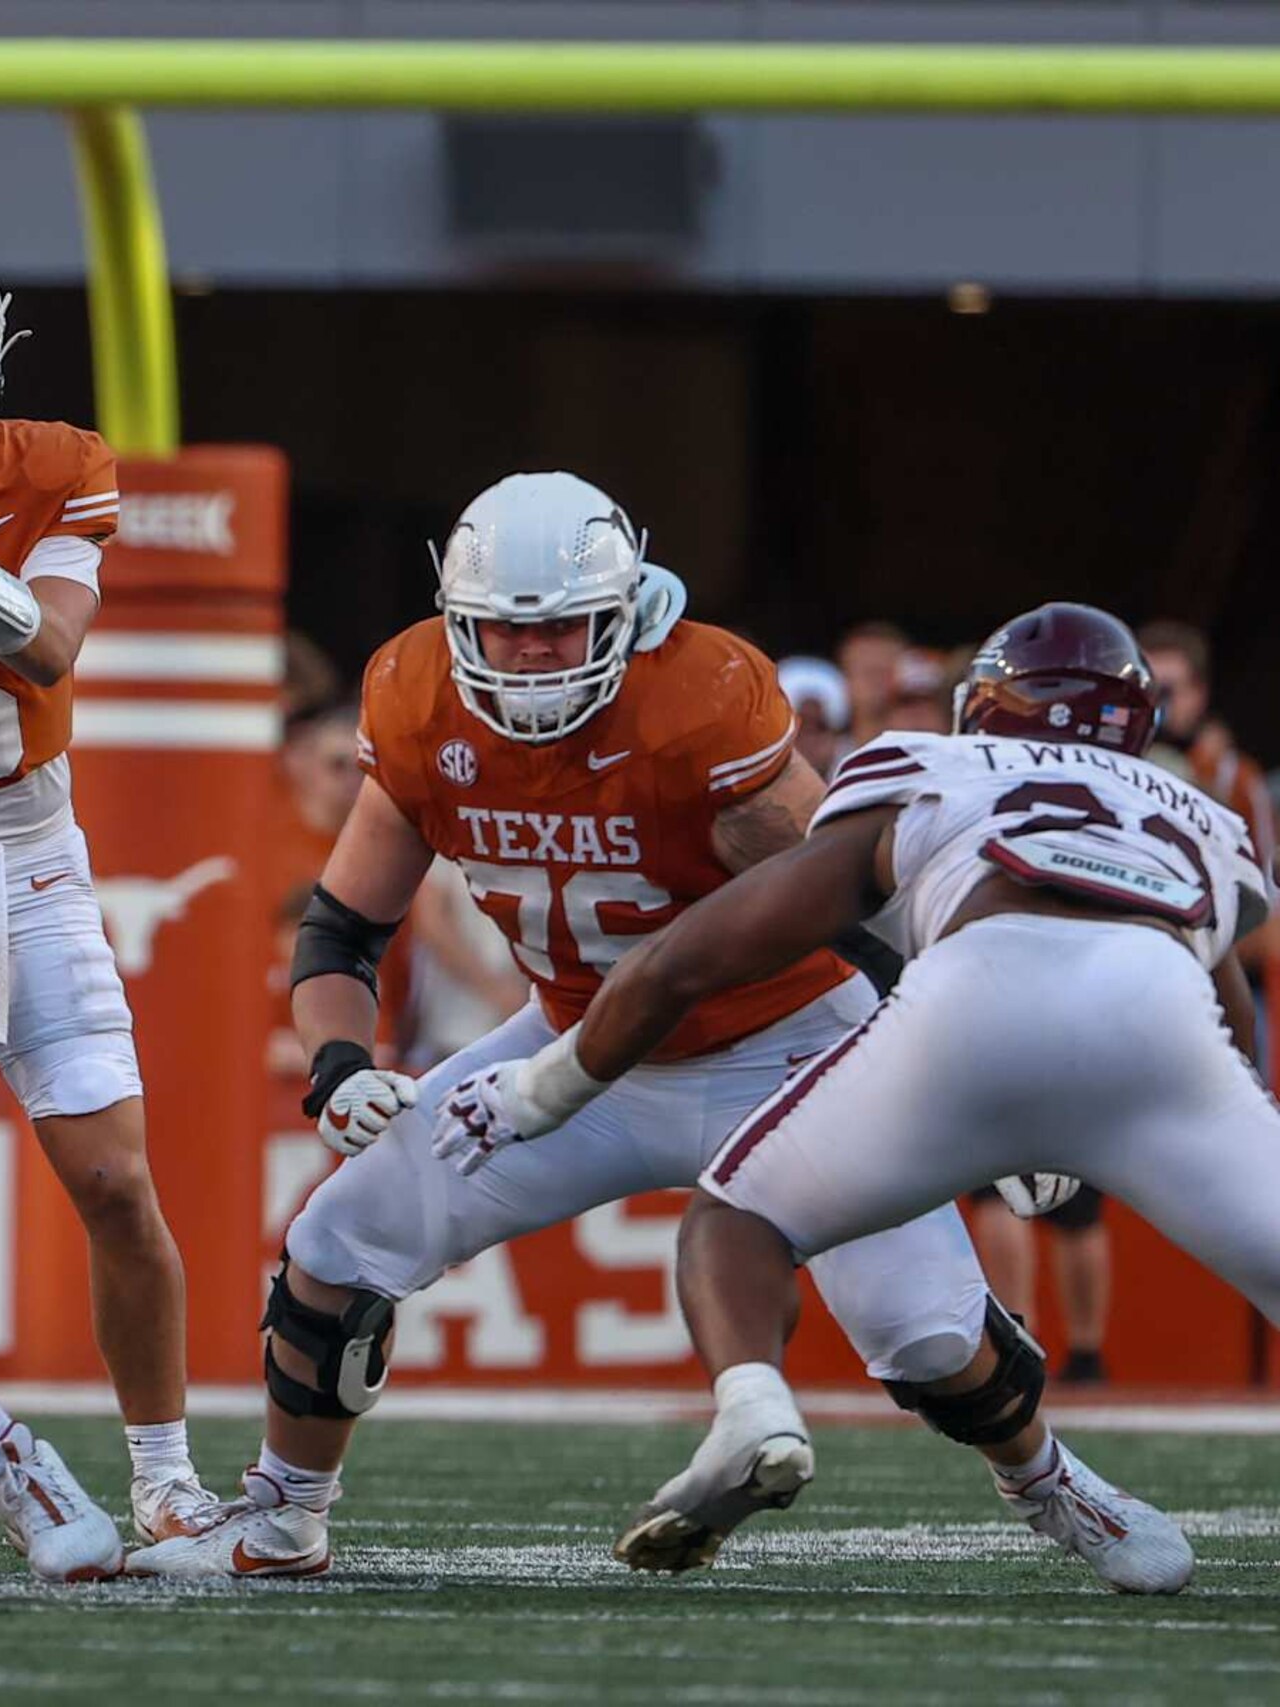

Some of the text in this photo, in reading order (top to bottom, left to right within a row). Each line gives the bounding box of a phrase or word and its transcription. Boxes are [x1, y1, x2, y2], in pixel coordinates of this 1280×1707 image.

[440, 743, 476, 781] SEC
[974, 743, 1212, 836] T. WILLIAMS
[457, 806, 641, 864] TEXAS
[1049, 852, 1167, 894] DOUGLAS
[458, 856, 671, 981] 76
